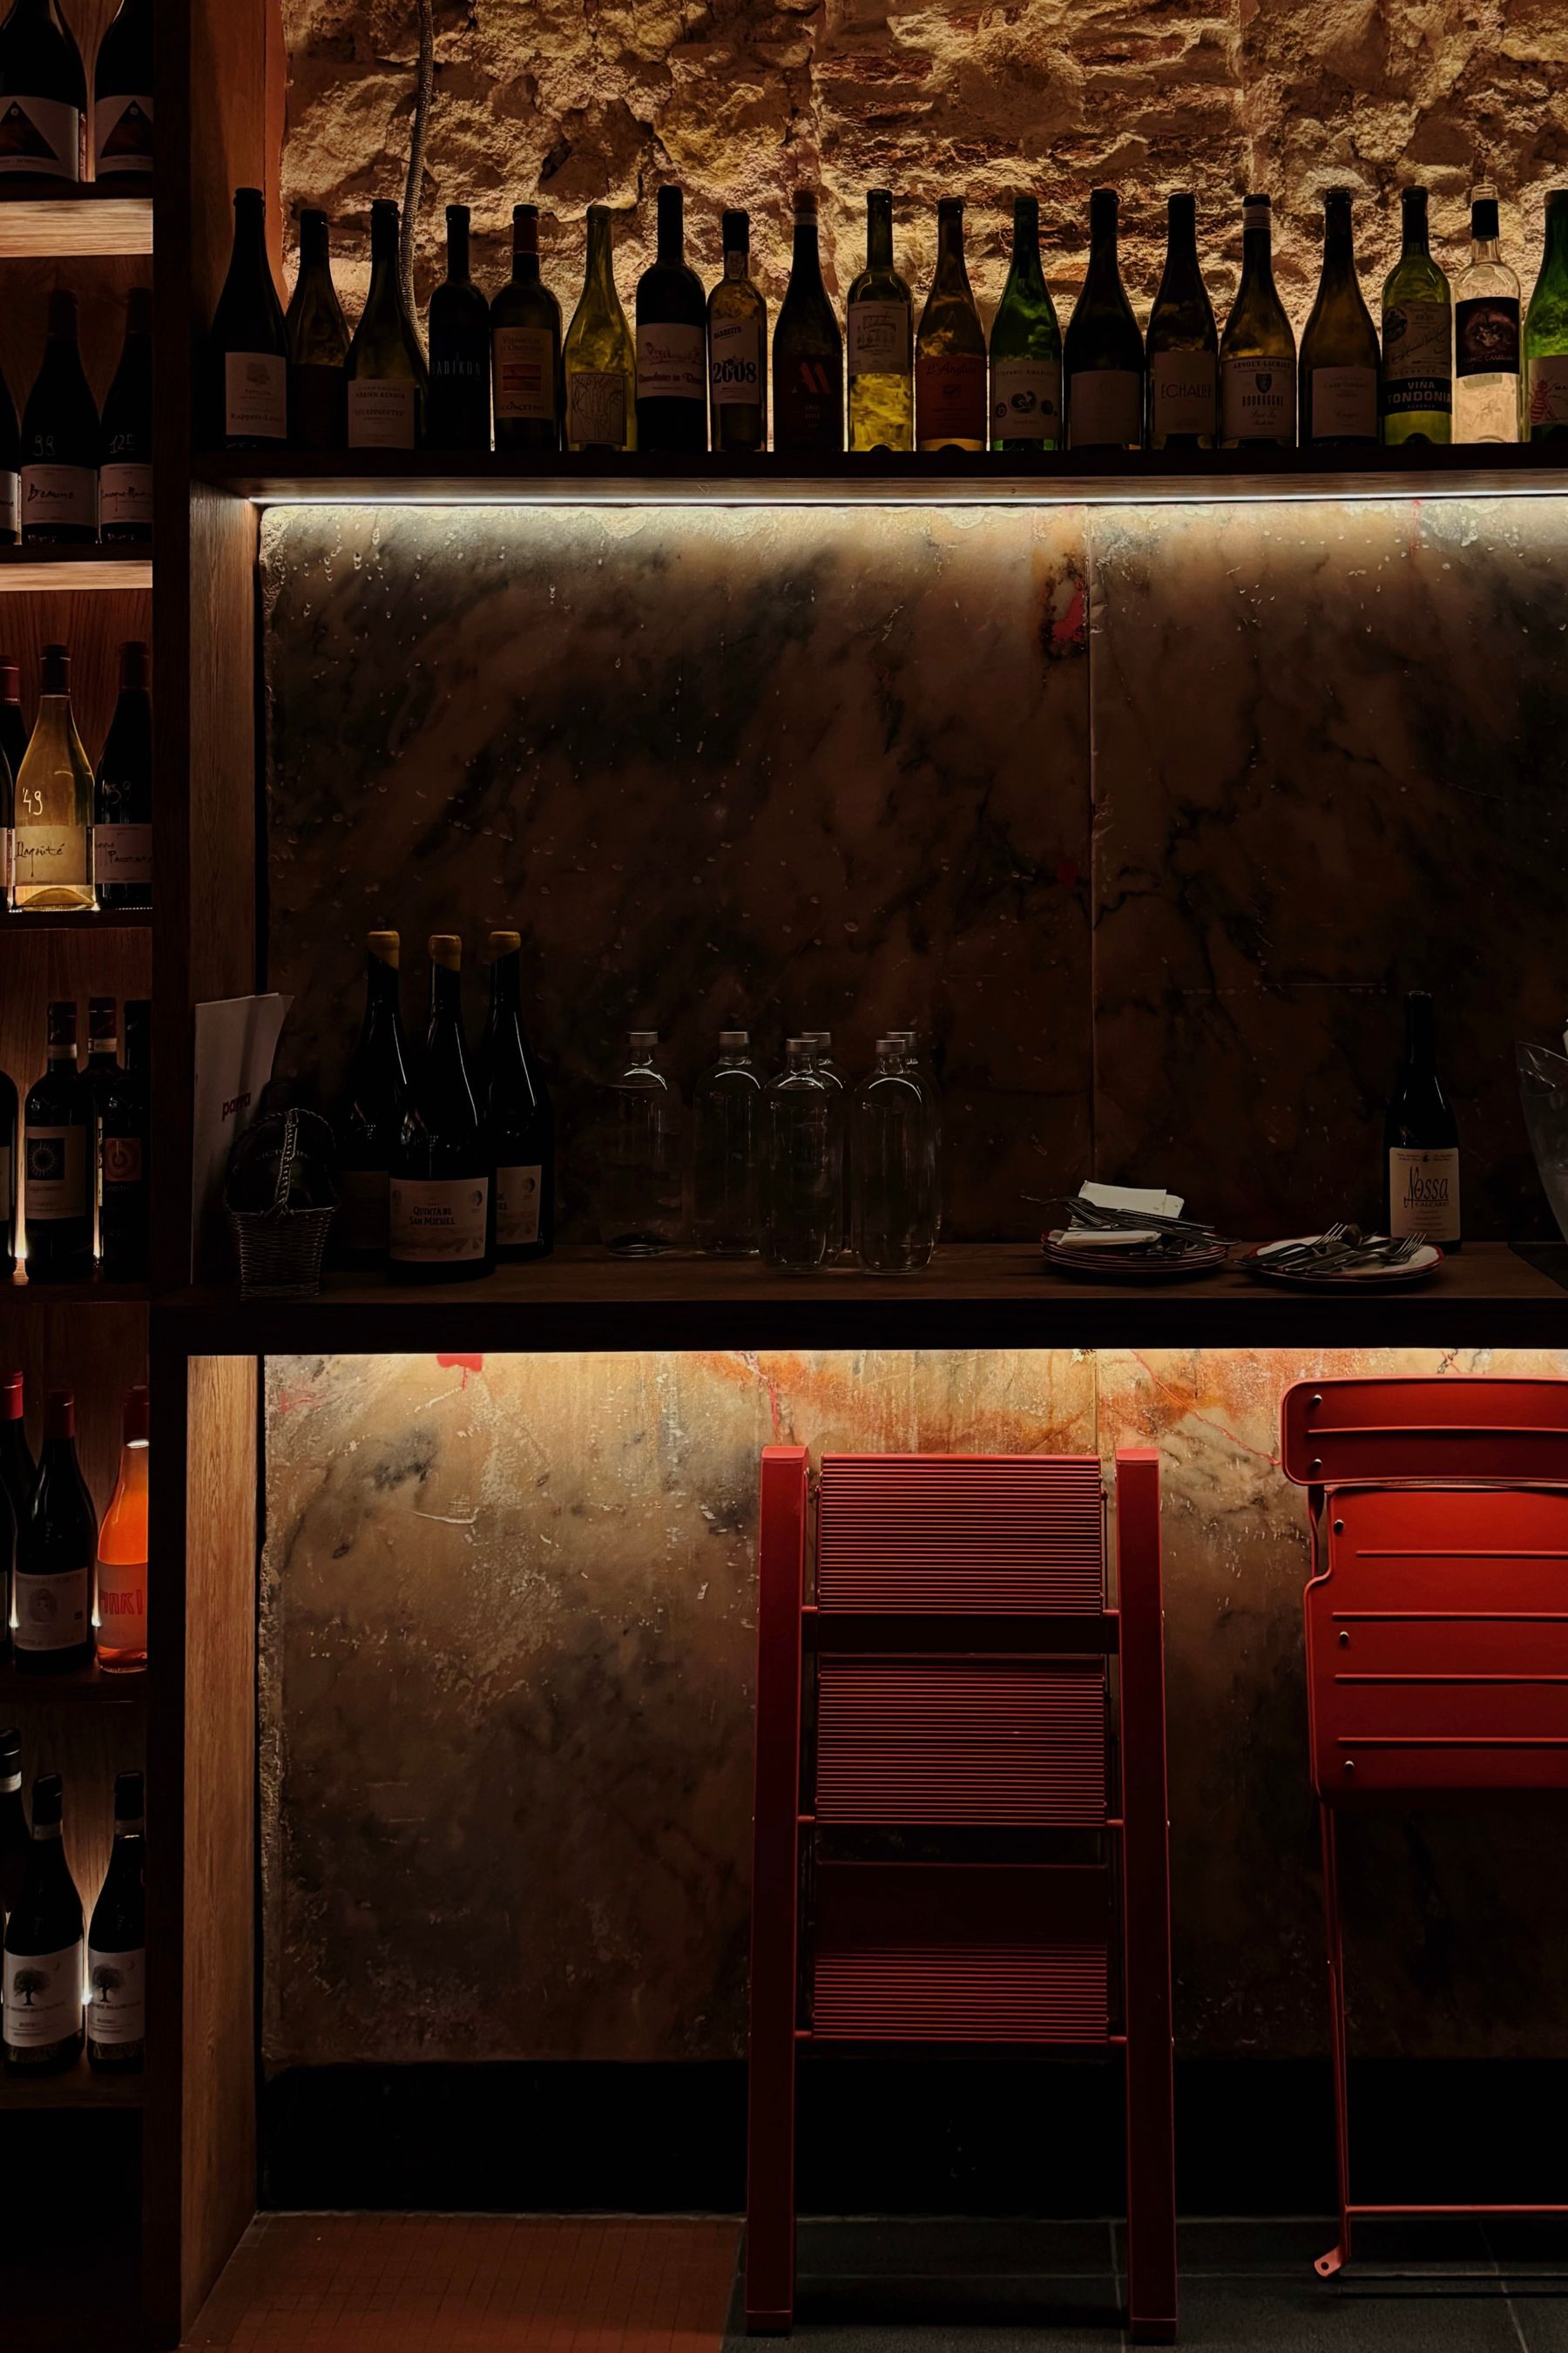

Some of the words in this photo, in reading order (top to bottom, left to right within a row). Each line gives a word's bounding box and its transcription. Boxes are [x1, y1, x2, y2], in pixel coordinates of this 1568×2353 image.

[713, 359, 756, 384] 2008
[1407, 380, 1436, 390] VIÑA
[1241, 396, 1285, 407] BOURGOGNE
[412, 1206, 441, 1216] QUINTA
